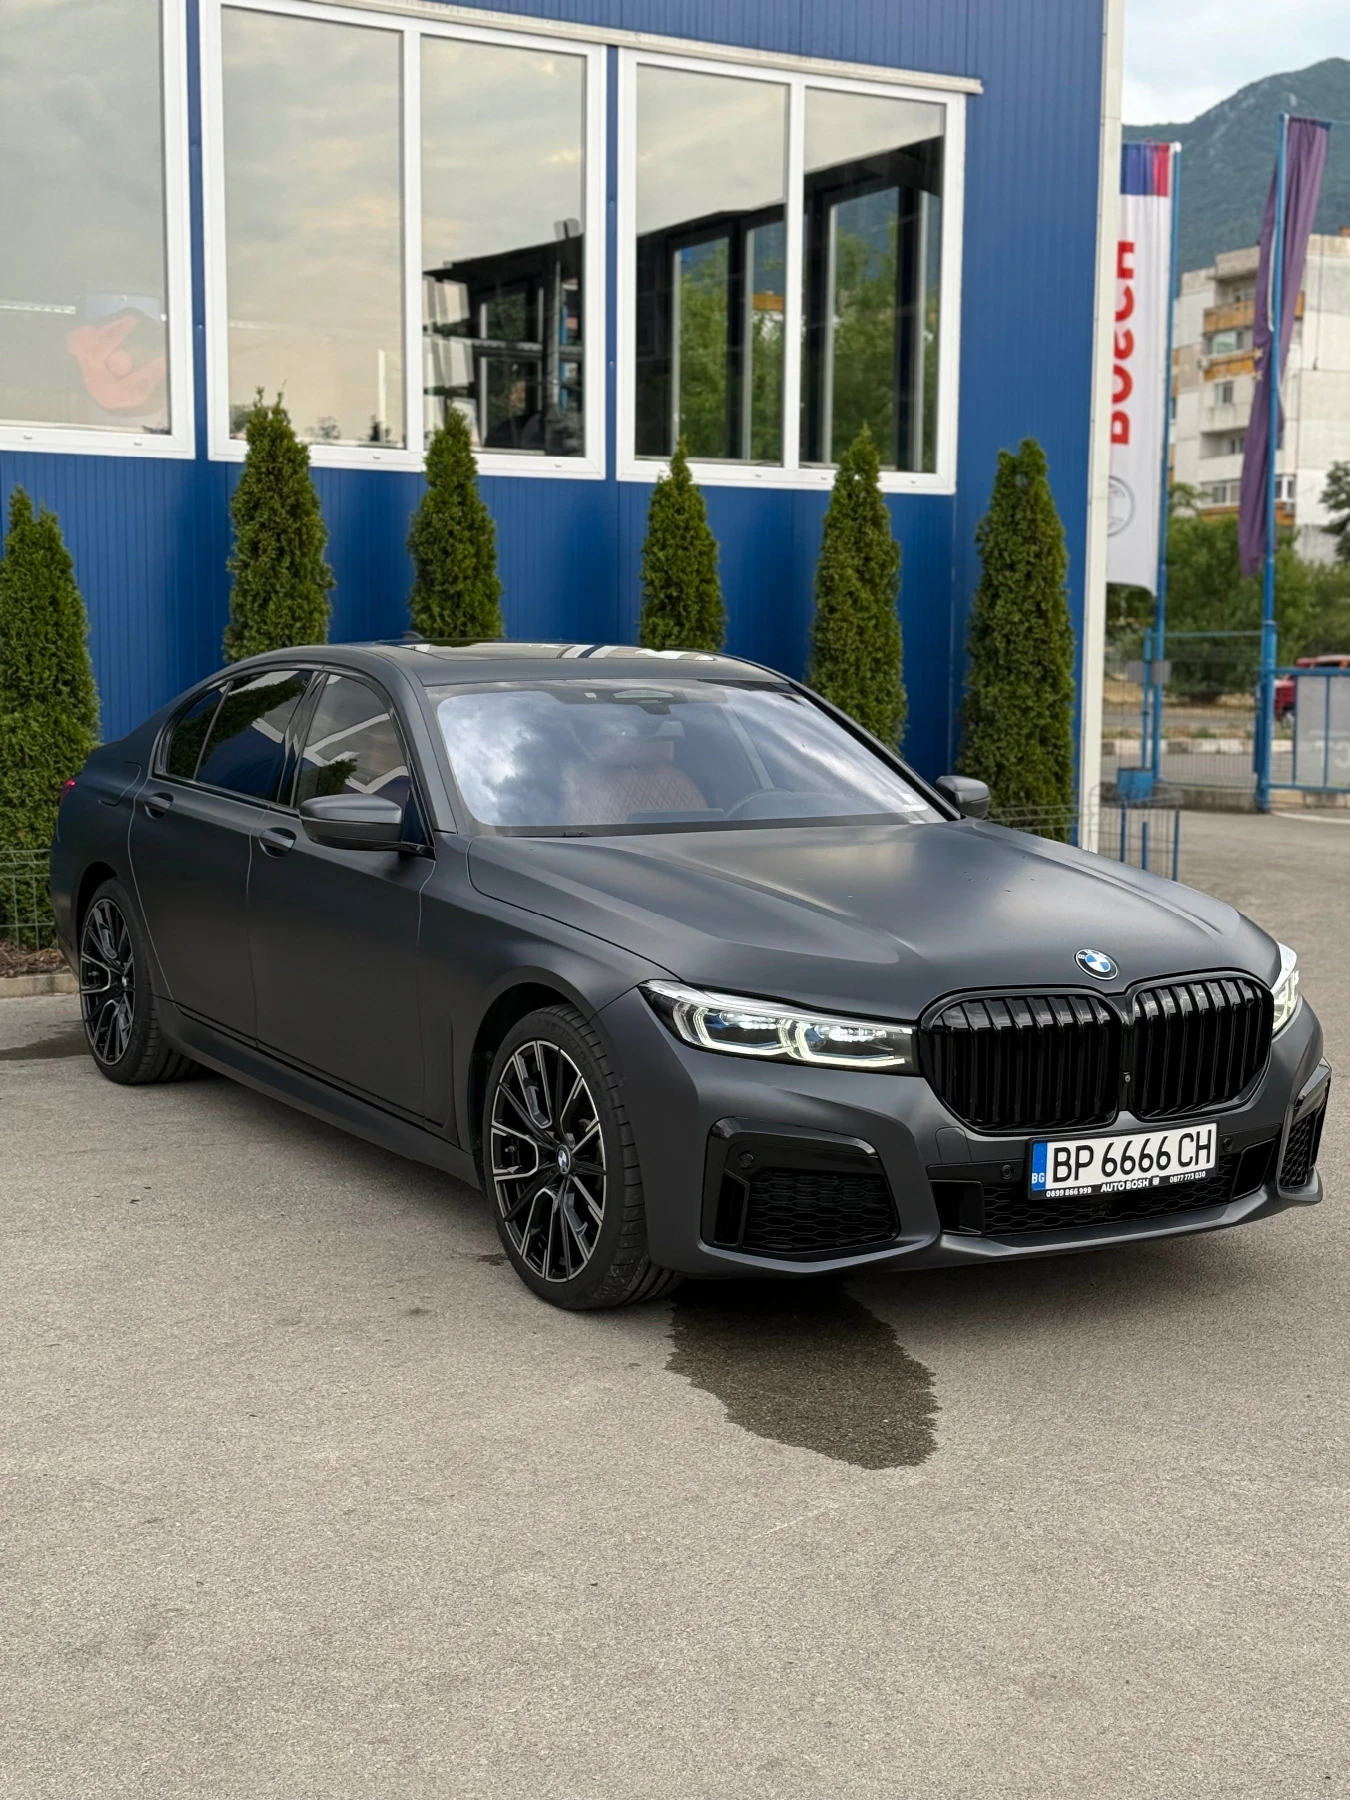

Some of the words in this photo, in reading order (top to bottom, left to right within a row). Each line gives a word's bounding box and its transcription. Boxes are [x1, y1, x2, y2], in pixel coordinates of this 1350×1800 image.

[1053, 1145, 1094, 1183] BP
[1101, 1136, 1171, 1177] 6666
[1178, 1129, 1212, 1167] CH
[1031, 1172, 1045, 1184] BG
[1169, 1175, 1184, 1183] 0877
[1184, 1173, 1195, 1181] 773
[1101, 1182, 1125, 1192] AUTO
[1126, 1178, 1149, 1190] BOSH
[1046, 1189, 1064, 1198] 0899
[1065, 1188, 1079, 1197] 866
[1079, 1186, 1092, 1195] 999
